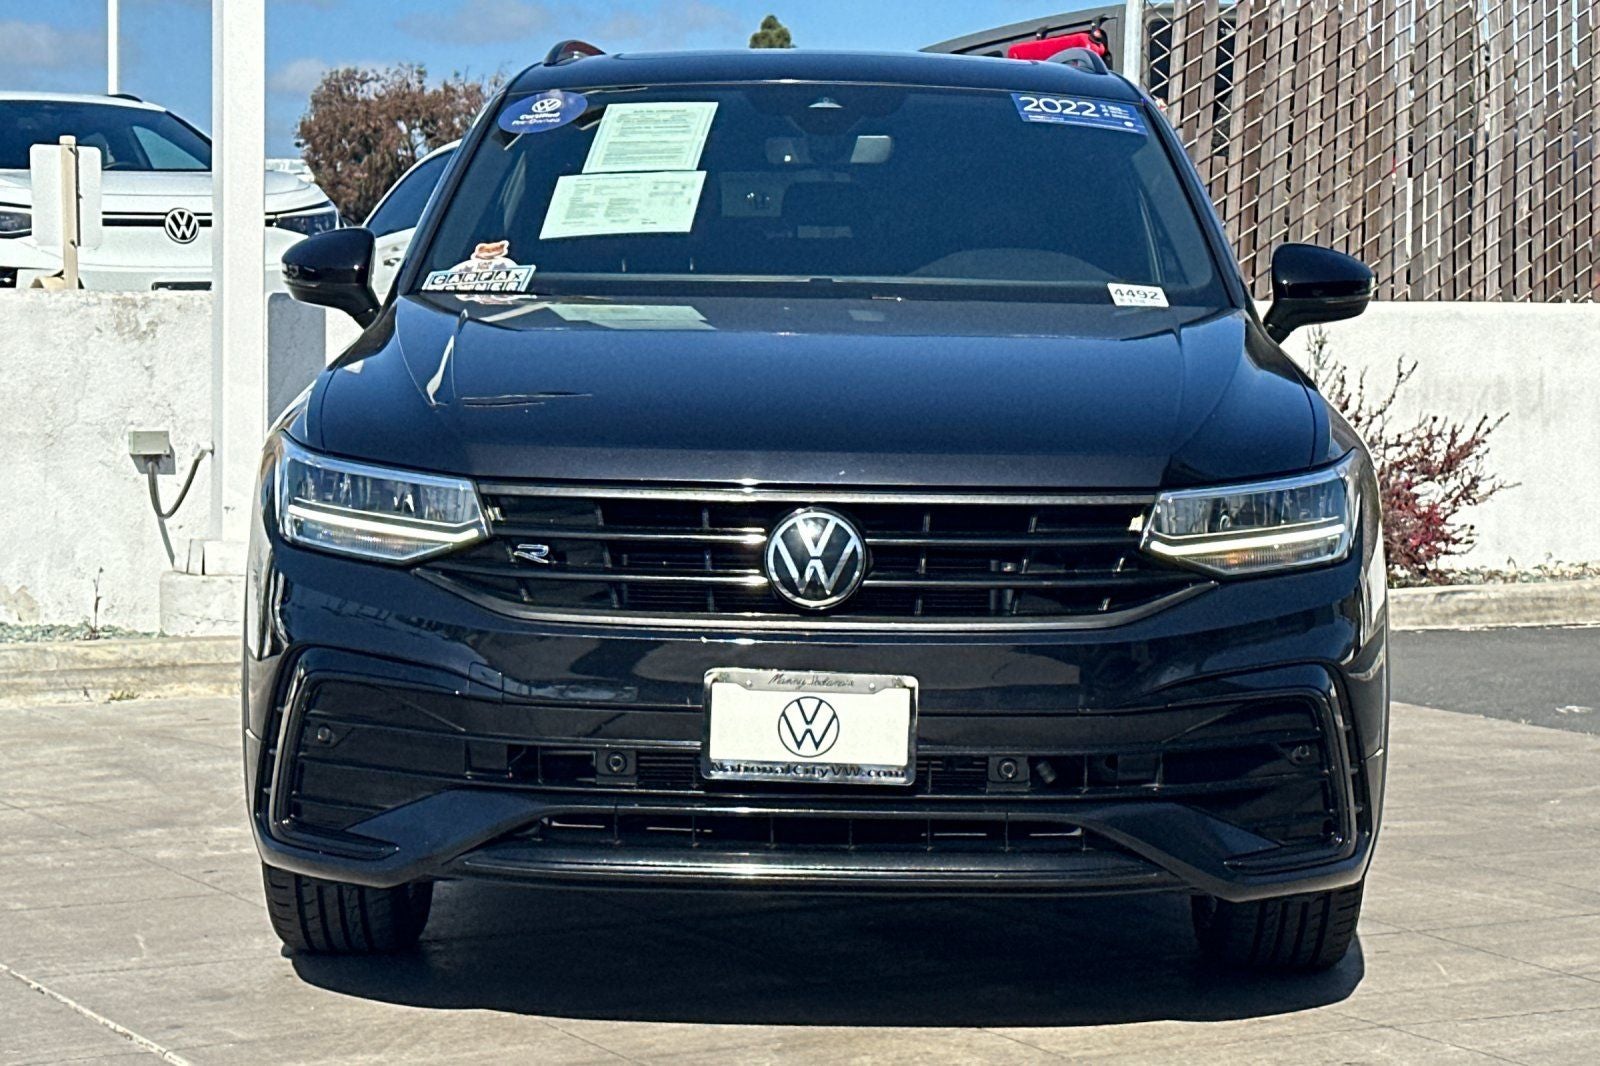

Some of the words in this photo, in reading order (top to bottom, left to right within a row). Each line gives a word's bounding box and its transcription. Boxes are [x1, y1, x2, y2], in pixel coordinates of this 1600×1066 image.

[1019, 96, 1100, 117] 2022
[432, 269, 524, 285] CARFAX
[1114, 288, 1161, 301] 4492
